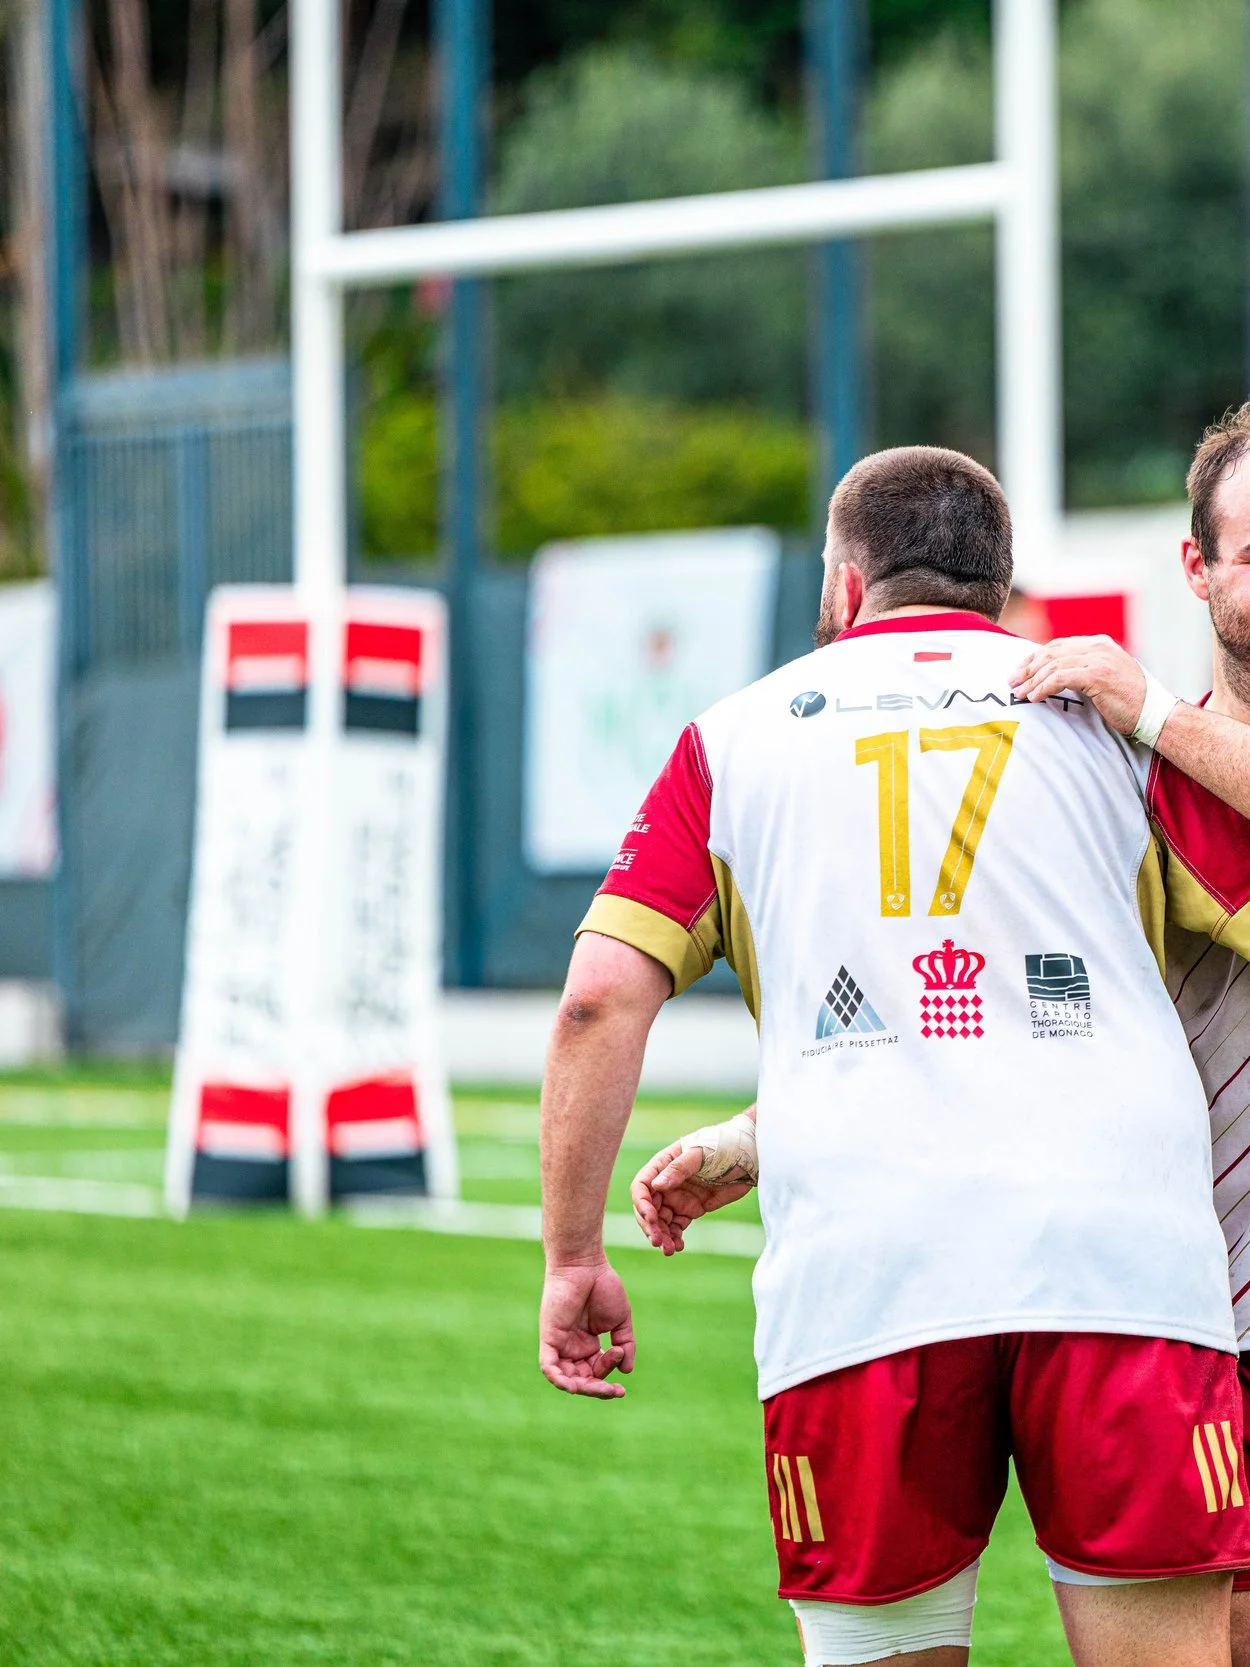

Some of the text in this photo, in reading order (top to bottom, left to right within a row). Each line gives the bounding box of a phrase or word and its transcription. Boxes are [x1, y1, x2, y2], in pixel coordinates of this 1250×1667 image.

[855, 720, 1020, 917] 17
[1029, 1000, 1092, 1011] CENTRE
[1030, 1010, 1091, 1020] CARDIO
[1031, 1019, 1093, 1029] THORACIQUE
[1032, 1029, 1094, 1039] DE MONACO
[849, 1035, 899, 1049] PISSETTAZ
